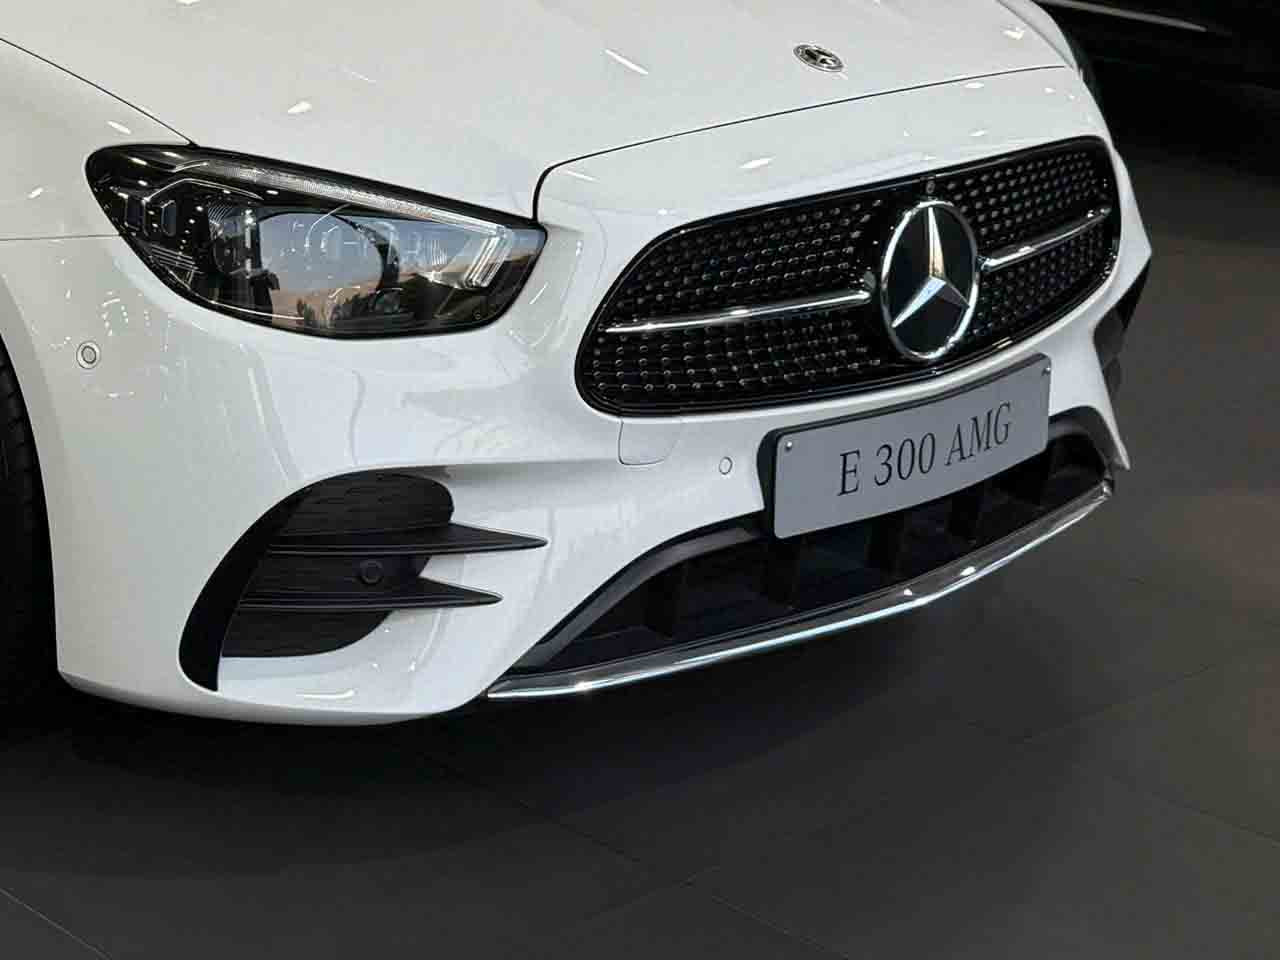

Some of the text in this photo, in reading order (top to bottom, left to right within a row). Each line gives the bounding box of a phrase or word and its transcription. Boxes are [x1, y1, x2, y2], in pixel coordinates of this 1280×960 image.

[837, 401, 1011, 497] E 300 AMG
